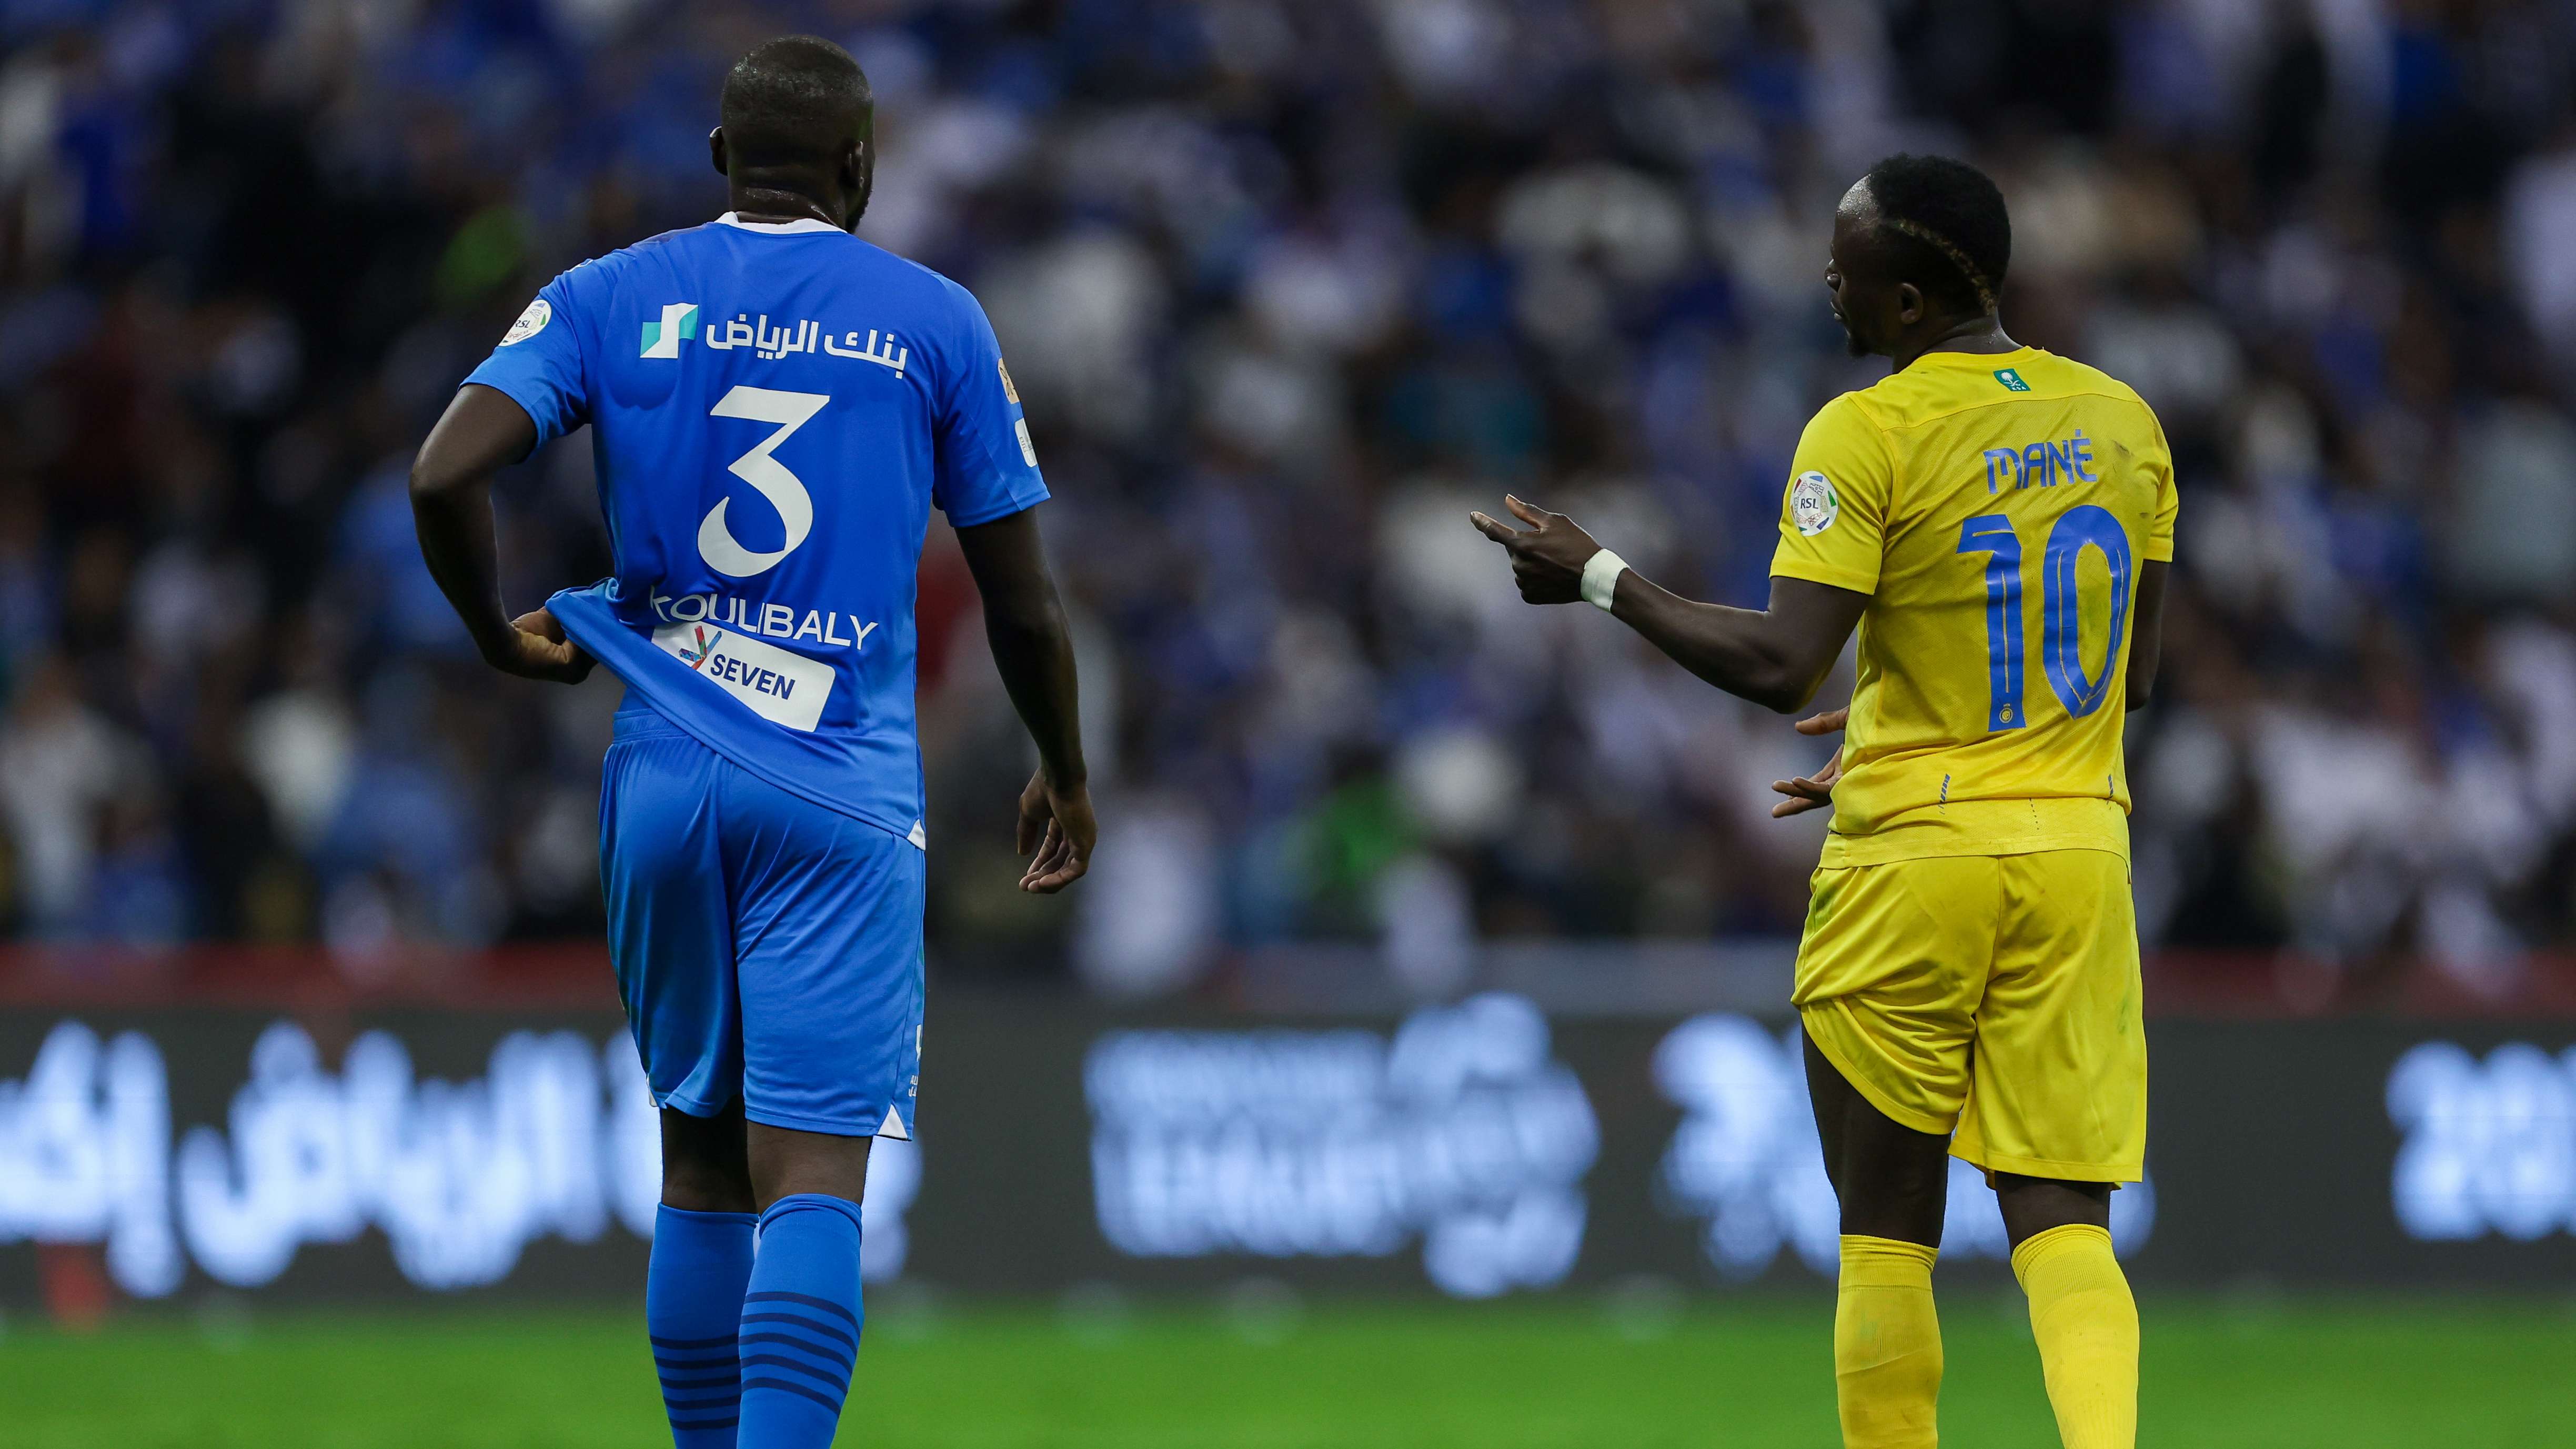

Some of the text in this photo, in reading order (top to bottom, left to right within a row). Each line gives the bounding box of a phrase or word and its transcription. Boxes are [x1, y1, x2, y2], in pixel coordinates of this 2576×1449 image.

[706, 314, 908, 379] بنك الرياض
[697, 385, 830, 578] 3
[1984, 428, 2098, 495] MANÉ
[1800, 497, 1819, 509] RSL
[1956, 504, 2132, 732] 10
[710, 653, 796, 700] SEVEN
